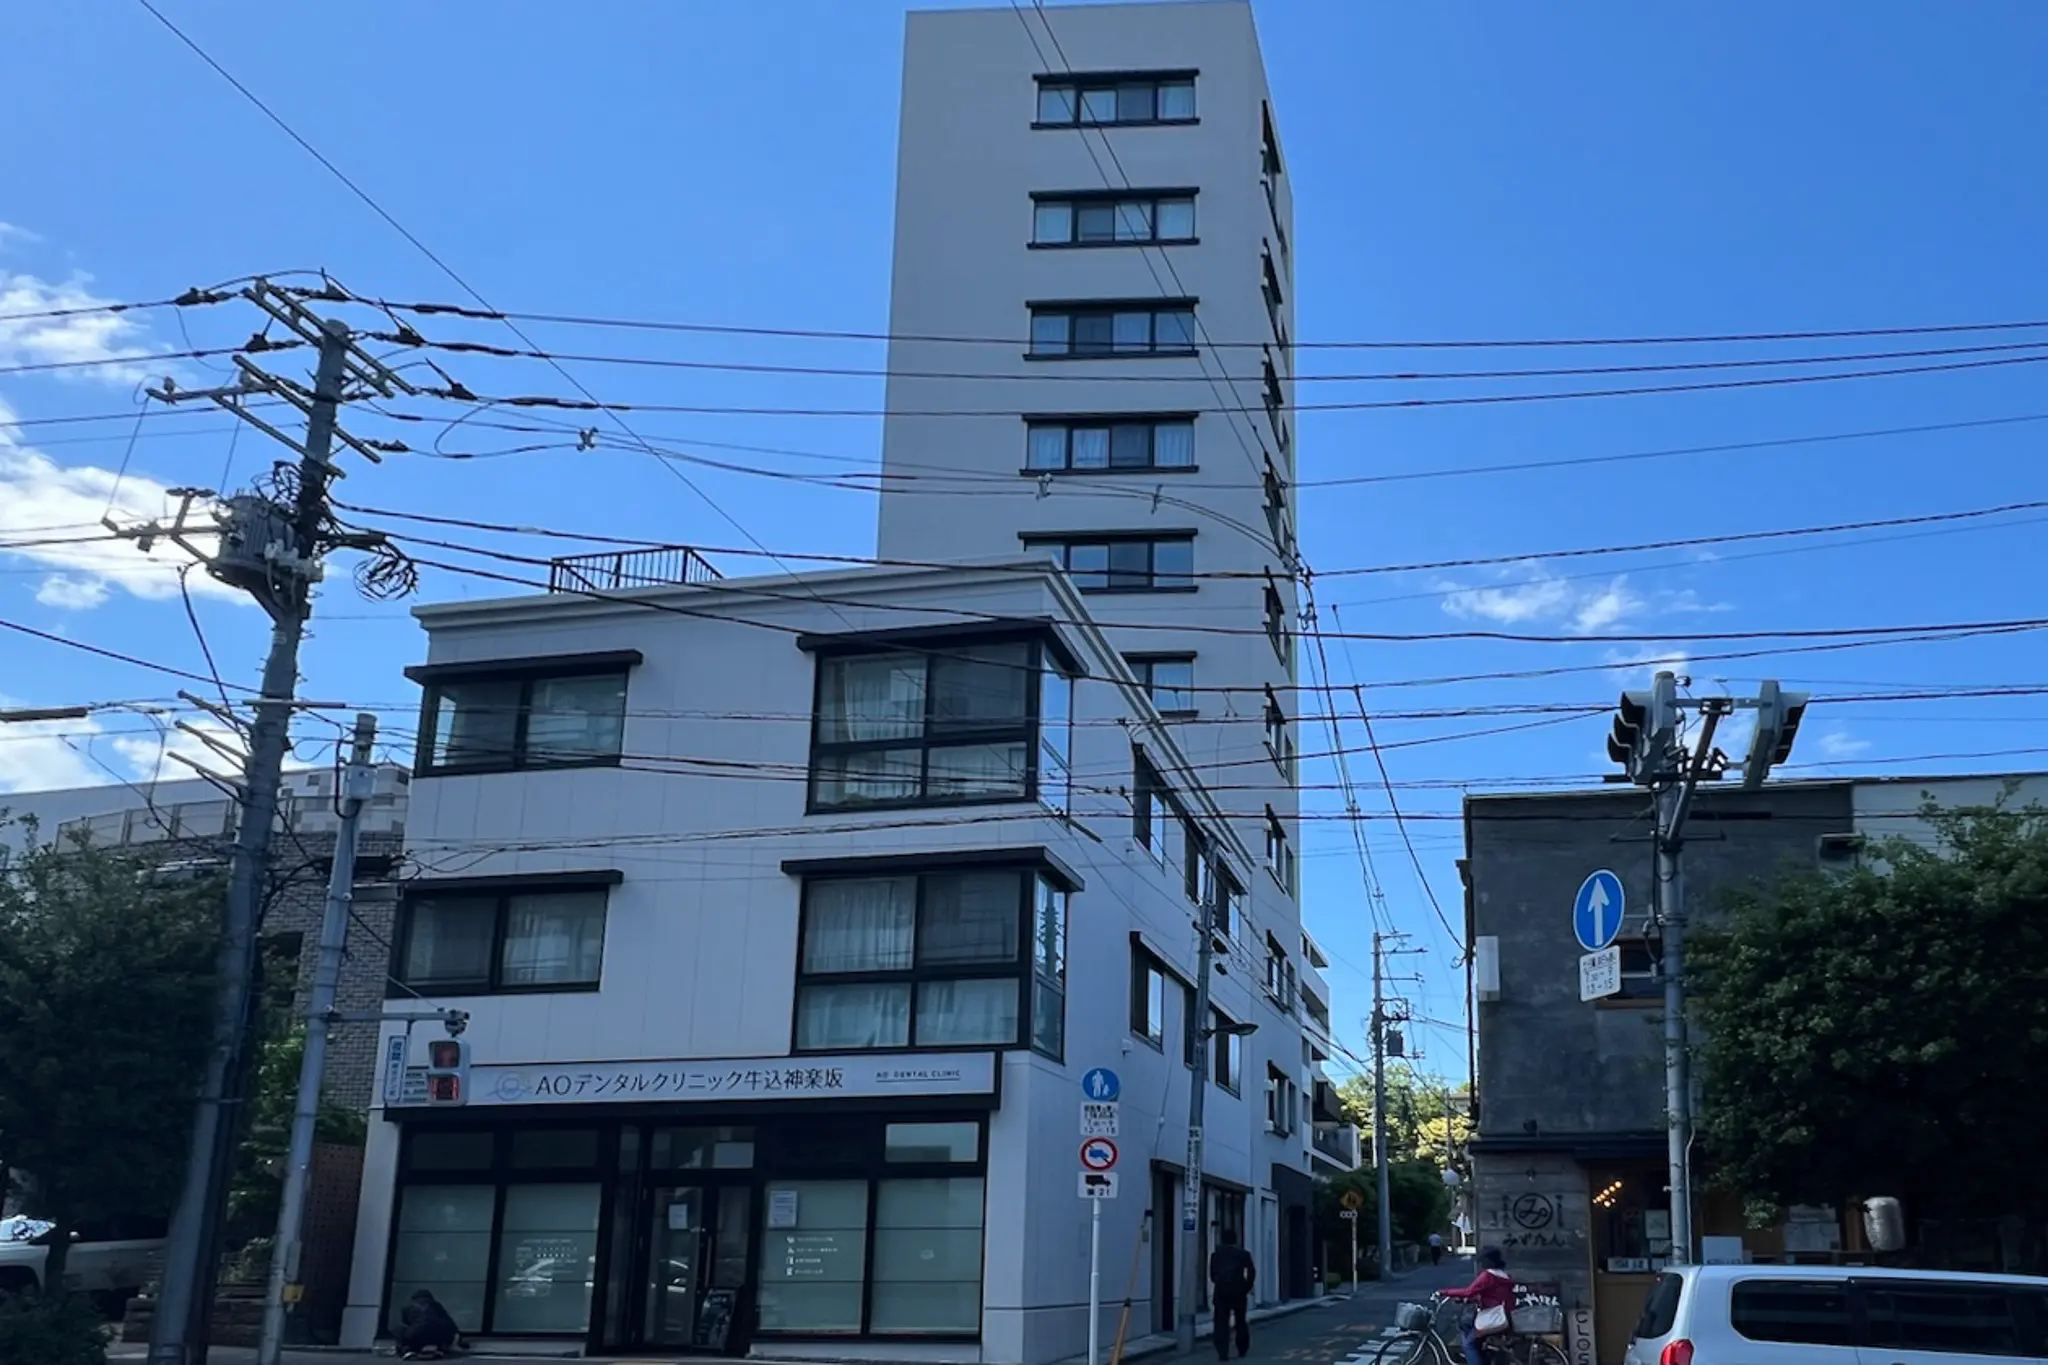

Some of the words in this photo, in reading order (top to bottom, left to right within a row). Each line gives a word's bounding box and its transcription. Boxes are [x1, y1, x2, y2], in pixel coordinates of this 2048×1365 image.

[535, 1067, 844, 1097] AOデンタルクリニック牛込神楽坂
[931, 1069, 960, 1077] CLINIC
